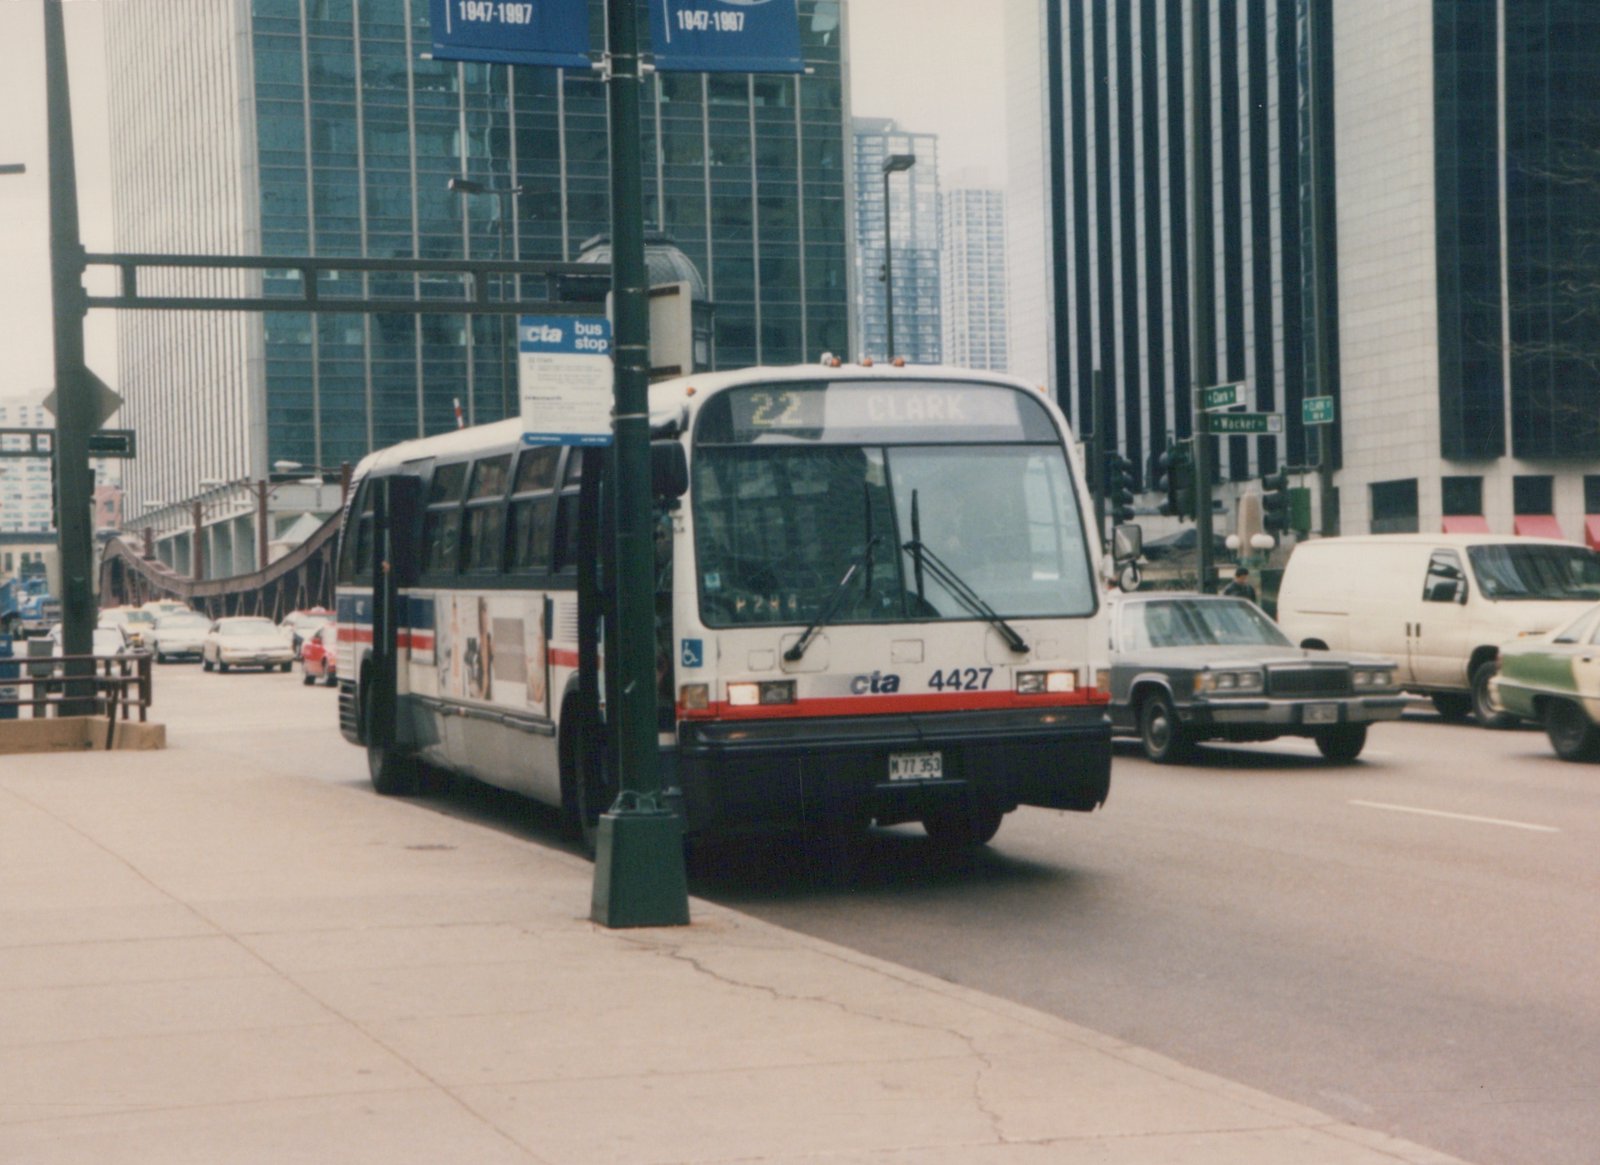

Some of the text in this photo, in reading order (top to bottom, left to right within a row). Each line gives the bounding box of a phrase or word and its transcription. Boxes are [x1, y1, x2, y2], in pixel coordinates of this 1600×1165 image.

[459, 1, 532, 24] 1947-1997
[677, 10, 744, 31] 1947-1997
[526, 324, 562, 342] cta
[574, 321, 602, 335] bus
[574, 336, 608, 352] stop
[751, 392, 967, 426] 22 CLARK
[1220, 416, 1256, 430] Wacker
[850, 668, 993, 694] cta 4427
[920, 757, 941, 773] 353
